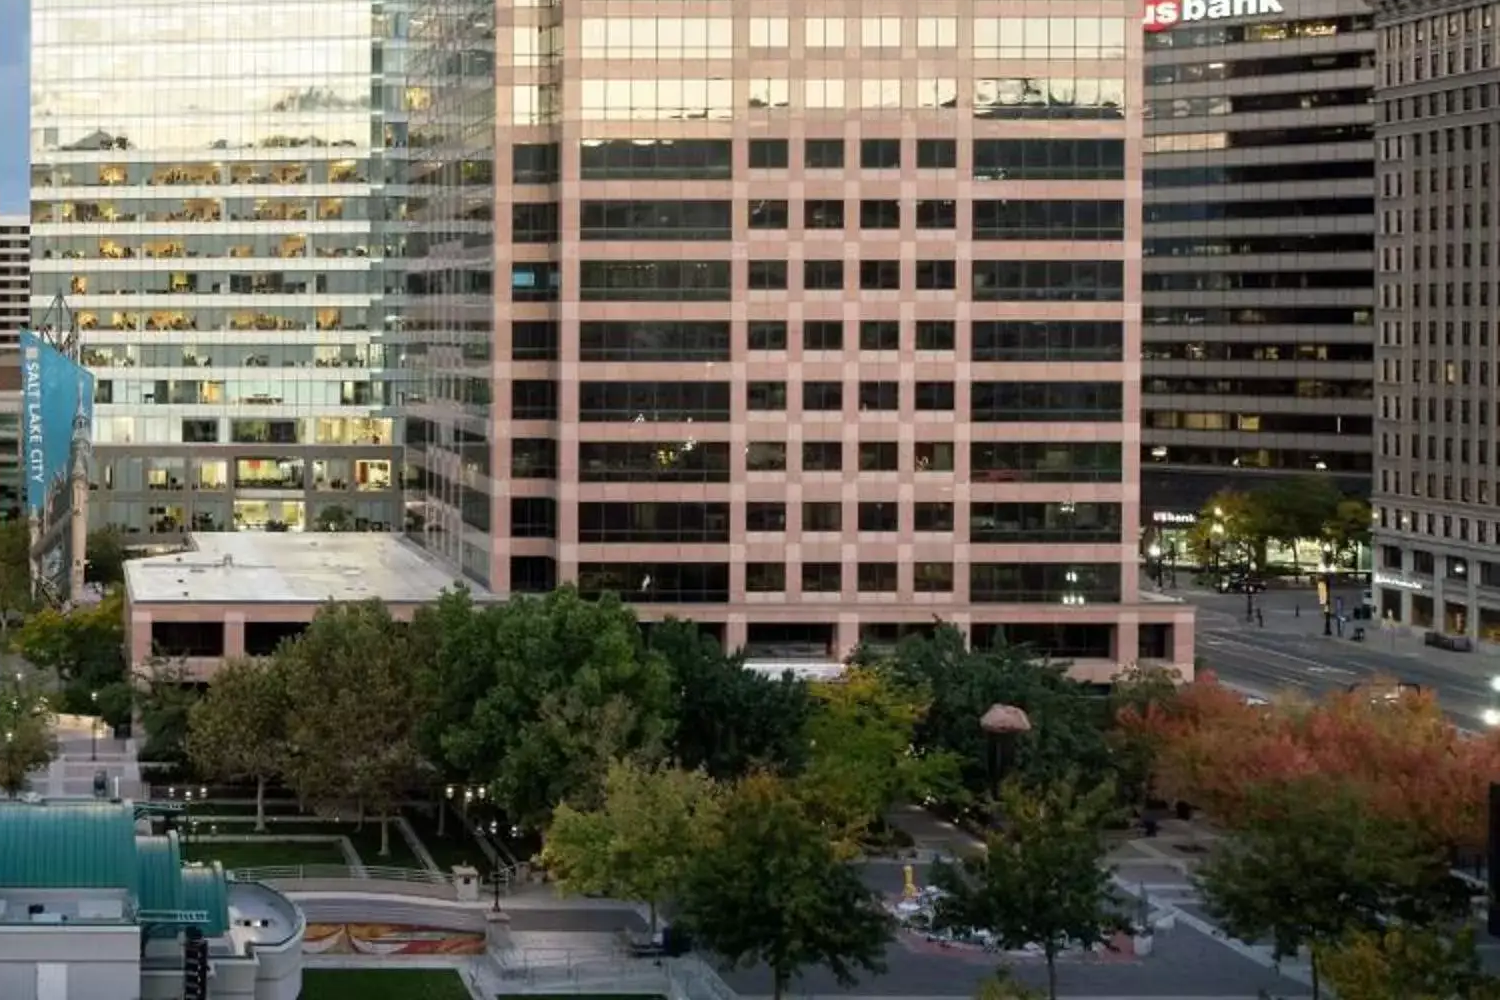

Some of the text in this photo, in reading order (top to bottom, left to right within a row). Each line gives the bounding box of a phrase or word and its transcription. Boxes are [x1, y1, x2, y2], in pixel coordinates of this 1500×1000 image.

[26, 362, 45, 483] SALT LAKE CITY
